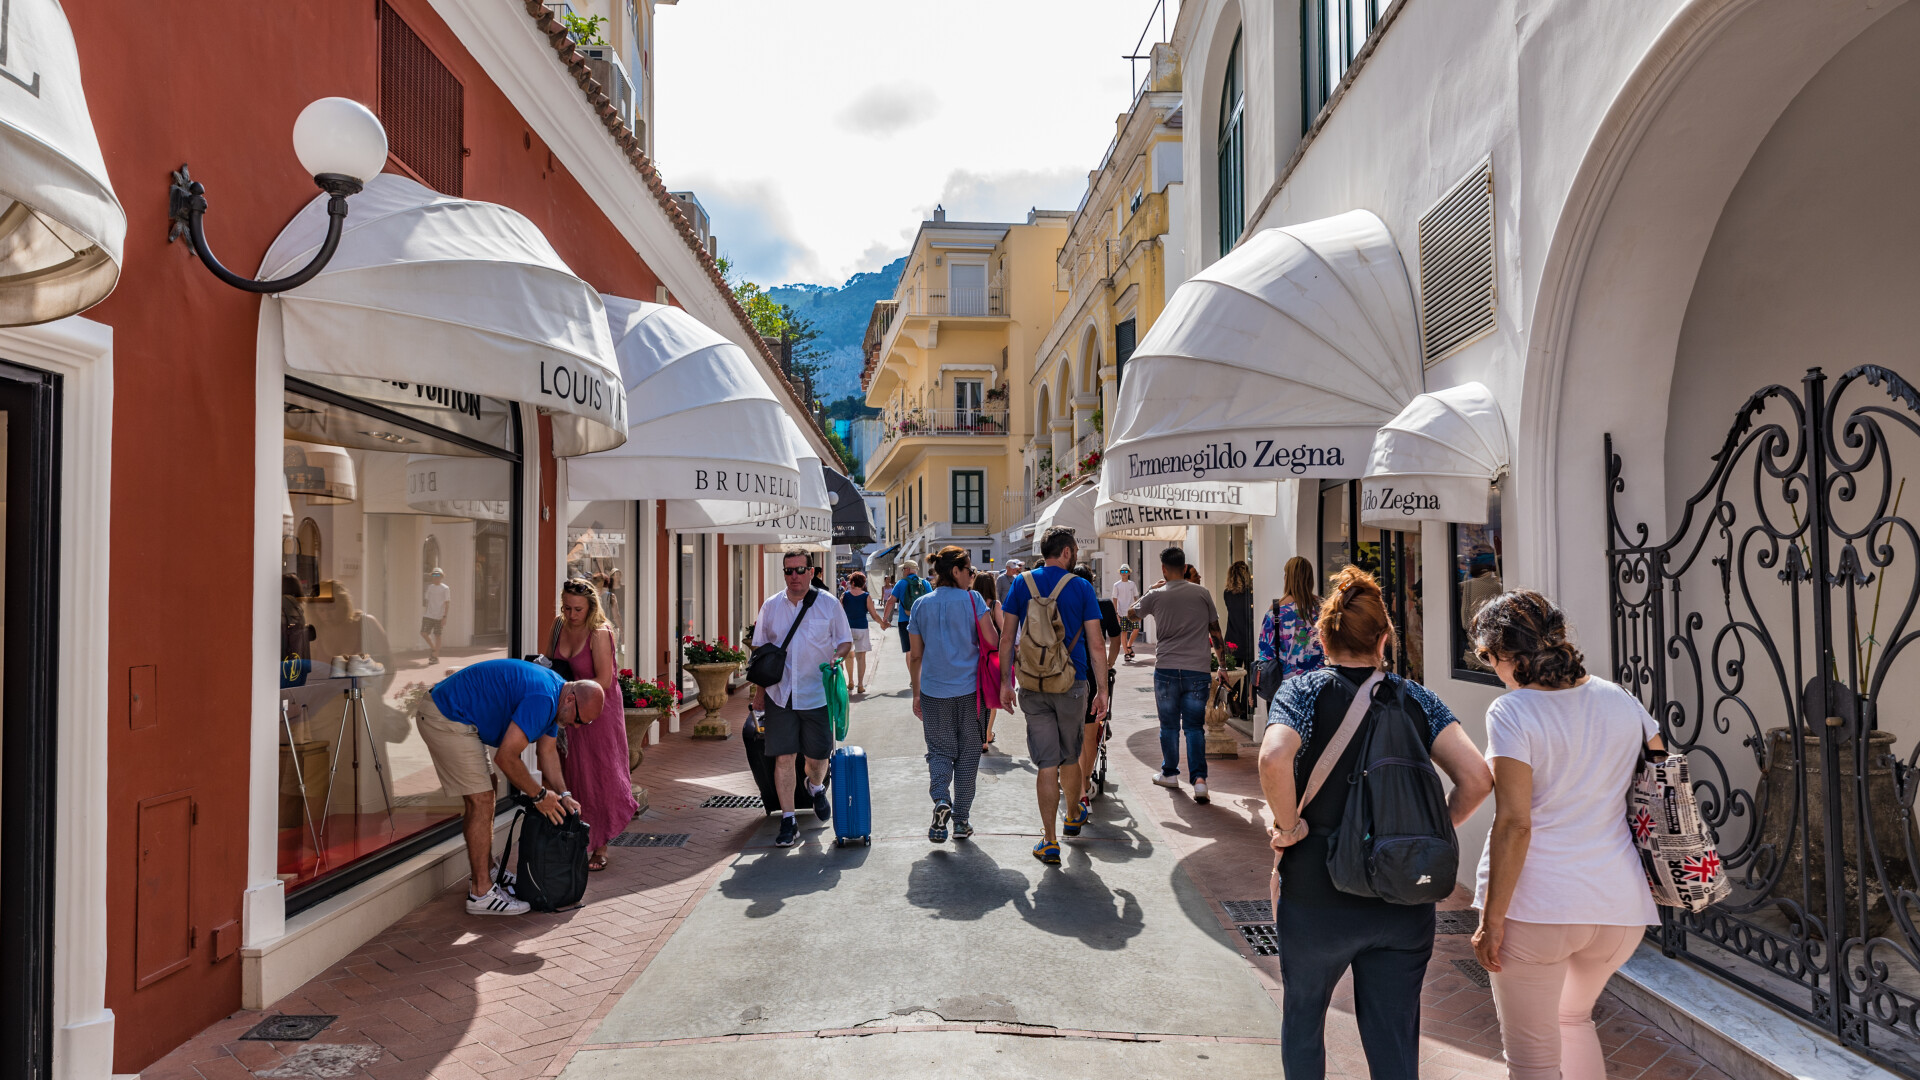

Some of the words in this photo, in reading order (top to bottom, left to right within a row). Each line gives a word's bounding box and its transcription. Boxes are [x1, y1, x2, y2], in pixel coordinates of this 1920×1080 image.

[541, 361, 602, 411] LOUIS
[1128, 442, 1248, 479] Ermenegildo
[1253, 440, 1345, 475] Zegna
[694, 469, 798, 500] BRUNELLO
[1379, 488, 1441, 516] Zegna
[1105, 507, 1135, 528] ALBERTA
[1668, 859, 1688, 886] FOR
